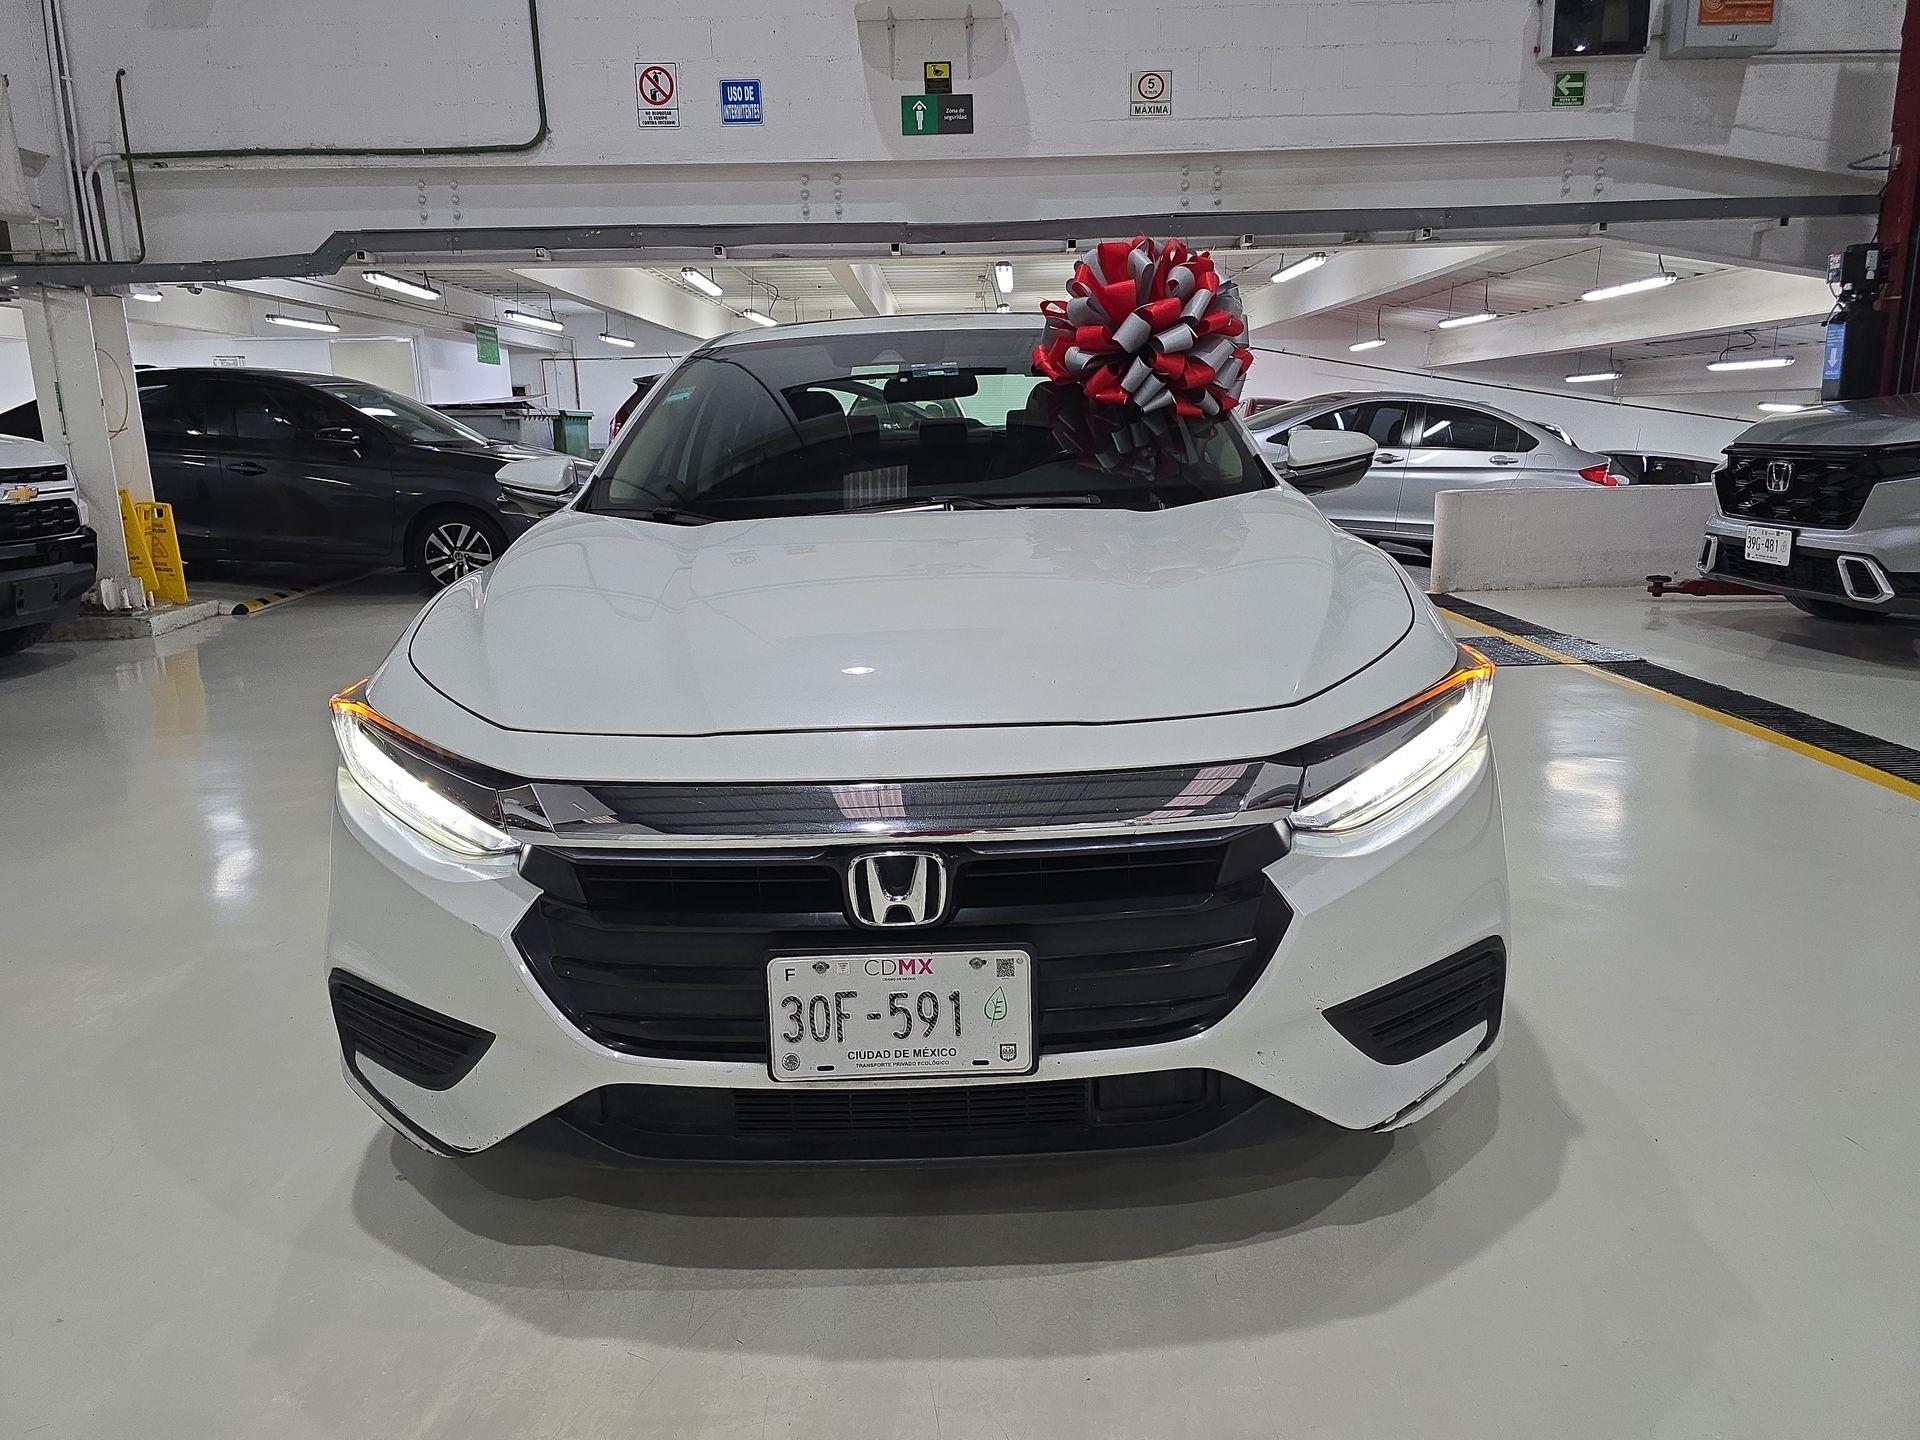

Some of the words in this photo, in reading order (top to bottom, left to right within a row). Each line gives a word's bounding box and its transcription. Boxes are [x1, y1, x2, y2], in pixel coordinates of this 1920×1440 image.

[1148, 79, 1155, 89] 5
[727, 86, 743, 101] USO
[743, 85, 755, 101] DE
[1134, 105, 1169, 114] MAXIMA
[864, 958, 934, 976] CDMX
[784, 968, 796, 982] F
[780, 989, 962, 1044] 30F-591
[847, 1050, 891, 1060] CIUDAD
[894, 1049, 910, 1058] DE
[913, 1047, 957, 1058] MÉXICO
